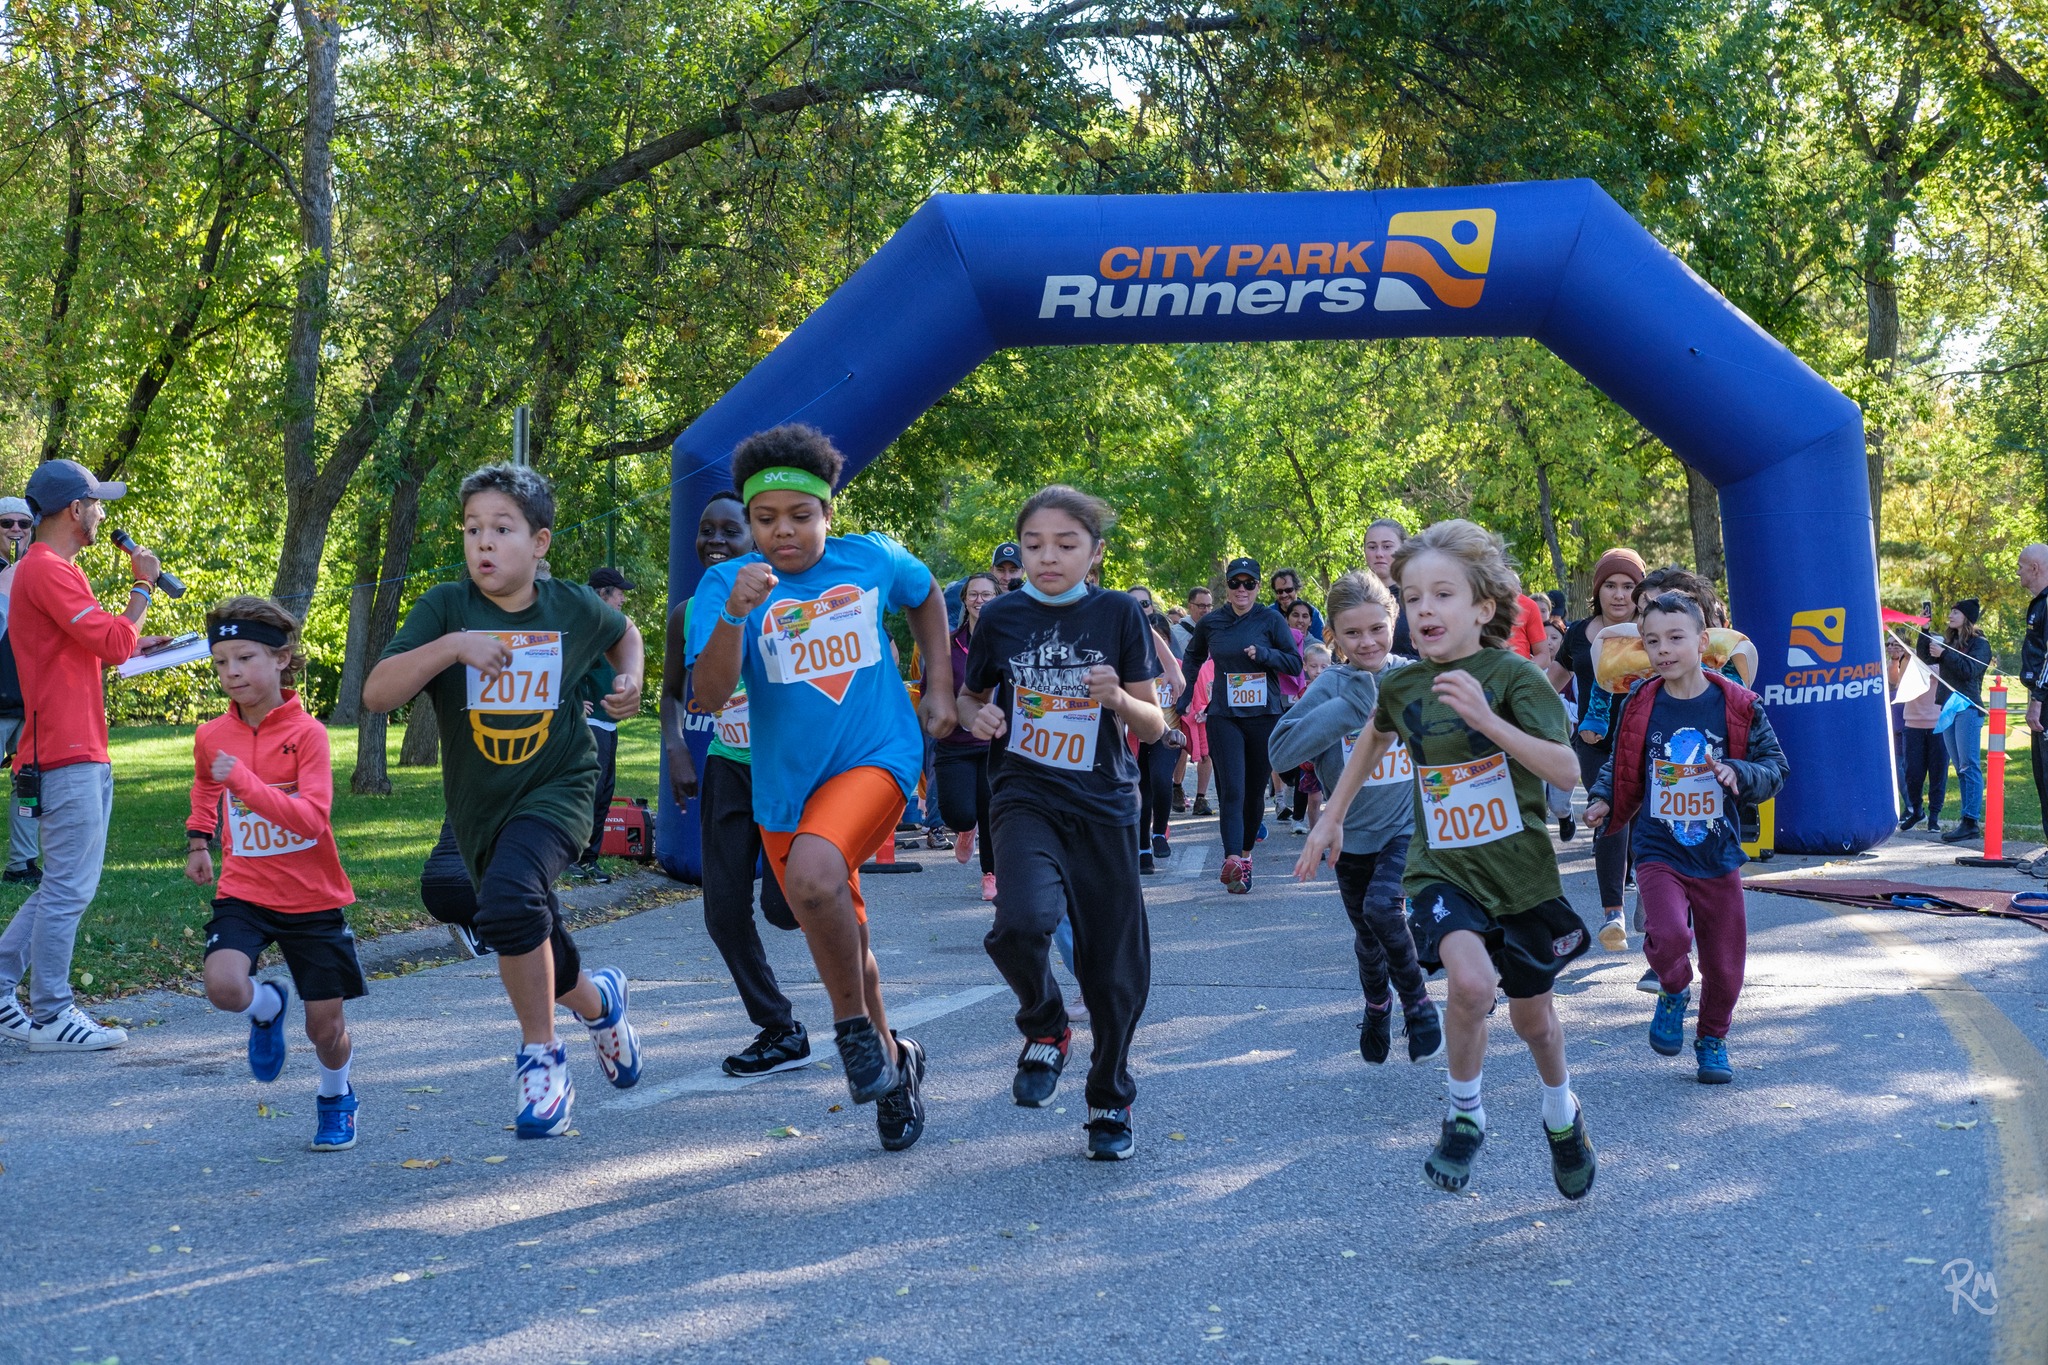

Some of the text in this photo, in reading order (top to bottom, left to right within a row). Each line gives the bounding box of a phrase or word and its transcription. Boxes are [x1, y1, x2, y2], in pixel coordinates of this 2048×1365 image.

[1100, 241, 1375, 280] CITY PARK
[1039, 275, 1367, 318] Runners
[814, 600, 831, 615] 2k
[831, 595, 851, 608] Run
[511, 634, 549, 647] 2k Run
[790, 631, 861, 675] 2080
[480, 671, 549, 703] 2074
[1785, 668, 1836, 687] CITY
[1233, 690, 1262, 704] 2081
[1764, 677, 1883, 706] Runners
[1052, 699, 1069, 710] 2k
[1069, 700, 1090, 709] Run
[718, 722, 751, 744] 207
[1020, 723, 1085, 763] 2070
[1367, 749, 1411, 780] 073
[1452, 767, 1470, 781] 2k
[1469, 761, 1493, 775] Run
[1683, 767, 1697, 776] 2k
[1660, 791, 1715, 817] 2055
[1434, 798, 1508, 841] 2020
[1024, 1043, 1060, 1066] NIKE
